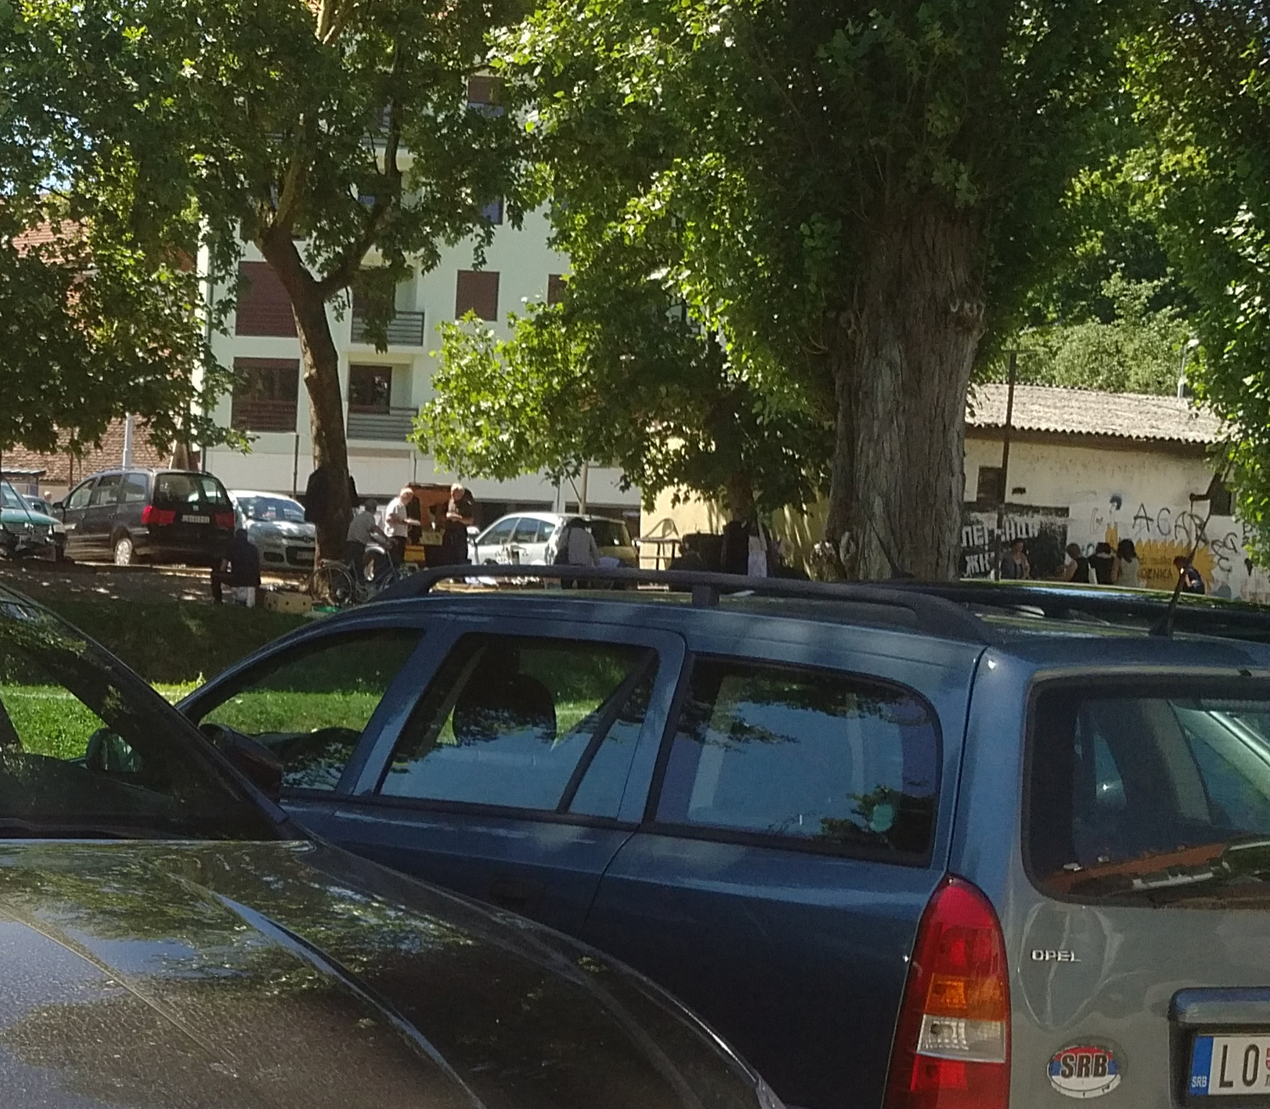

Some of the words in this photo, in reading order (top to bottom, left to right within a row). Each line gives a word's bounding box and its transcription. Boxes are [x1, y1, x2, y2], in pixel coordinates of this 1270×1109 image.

[1031, 950, 1081, 962] OPEL
[1060, 1053, 1108, 1079] SRB
[1191, 1075, 1208, 1088] SRB
